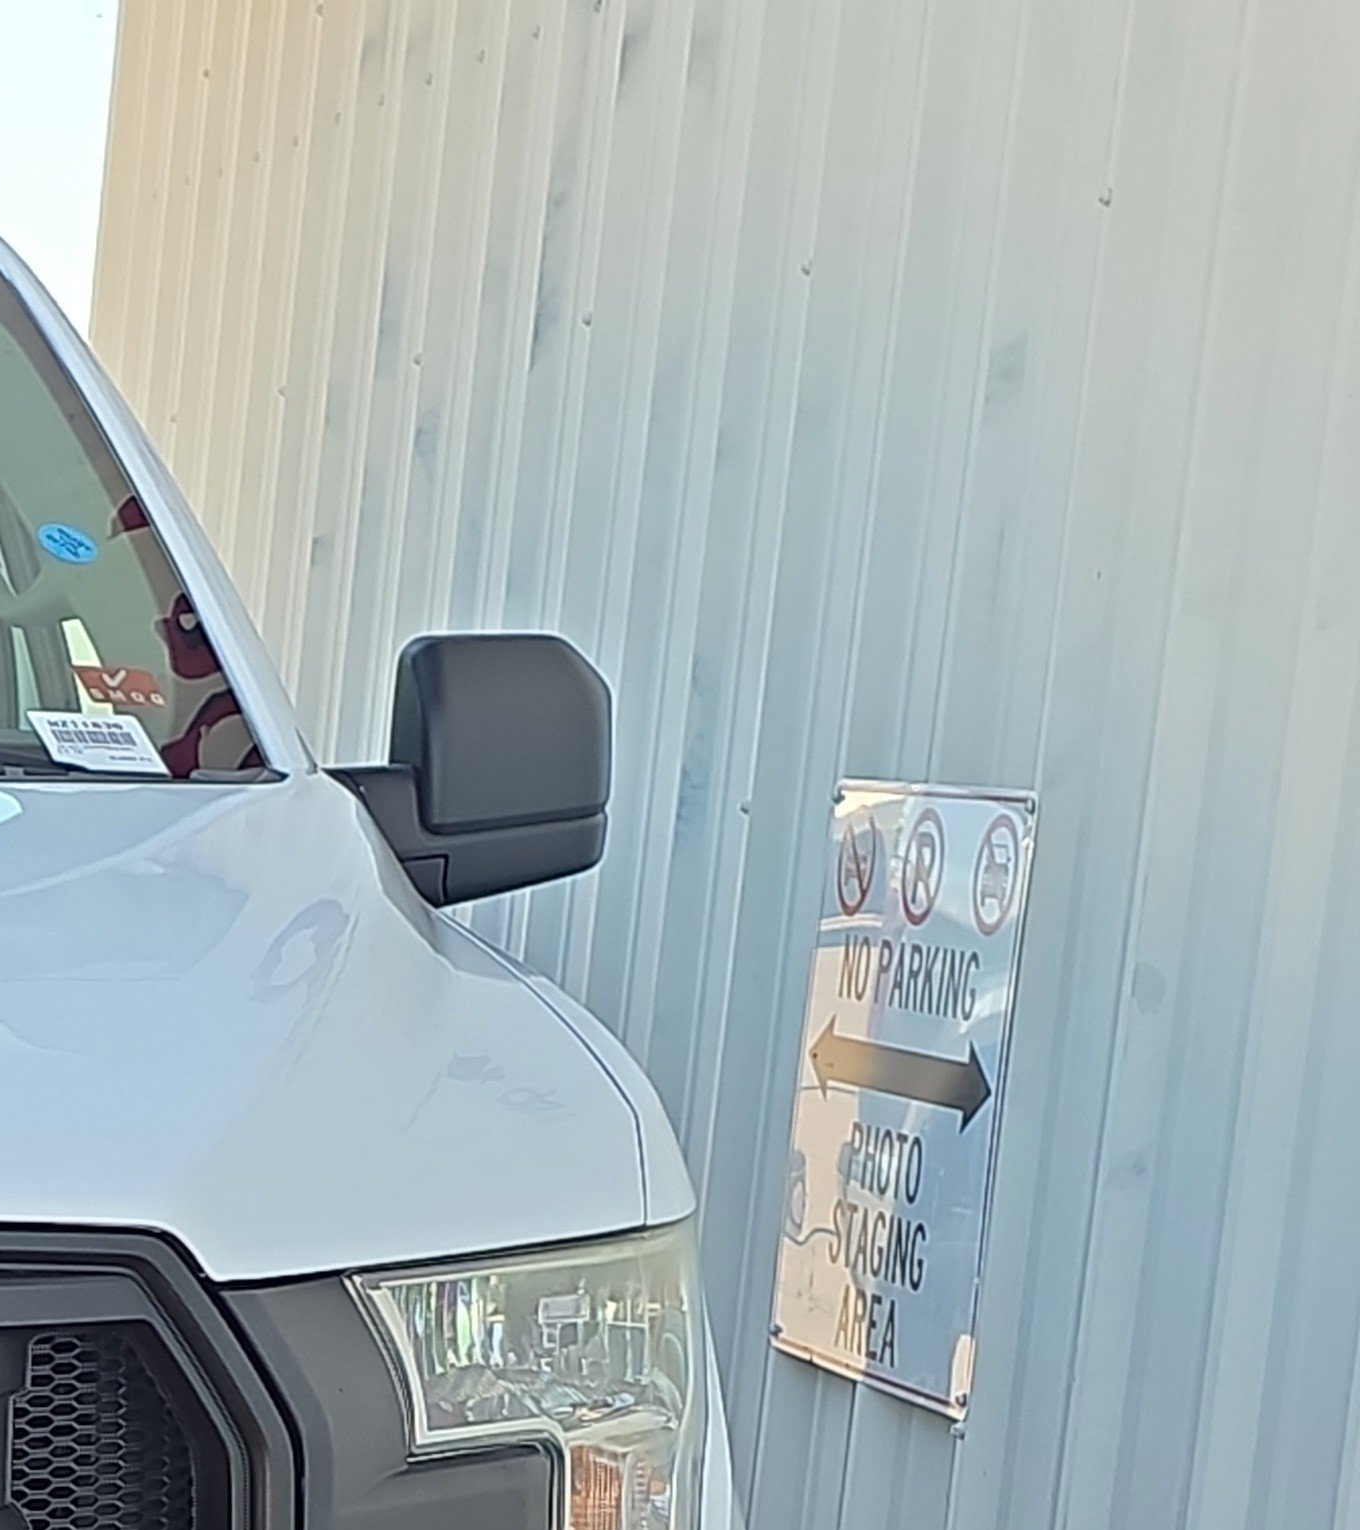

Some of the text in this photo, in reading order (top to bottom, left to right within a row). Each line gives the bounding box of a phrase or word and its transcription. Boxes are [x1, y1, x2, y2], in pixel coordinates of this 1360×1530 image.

[838, 934, 980, 1022] NO PARKING
[846, 1121, 924, 1205] PHOTO
[828, 1211, 927, 1292] STAGING
[834, 1290, 897, 1369] AREA
